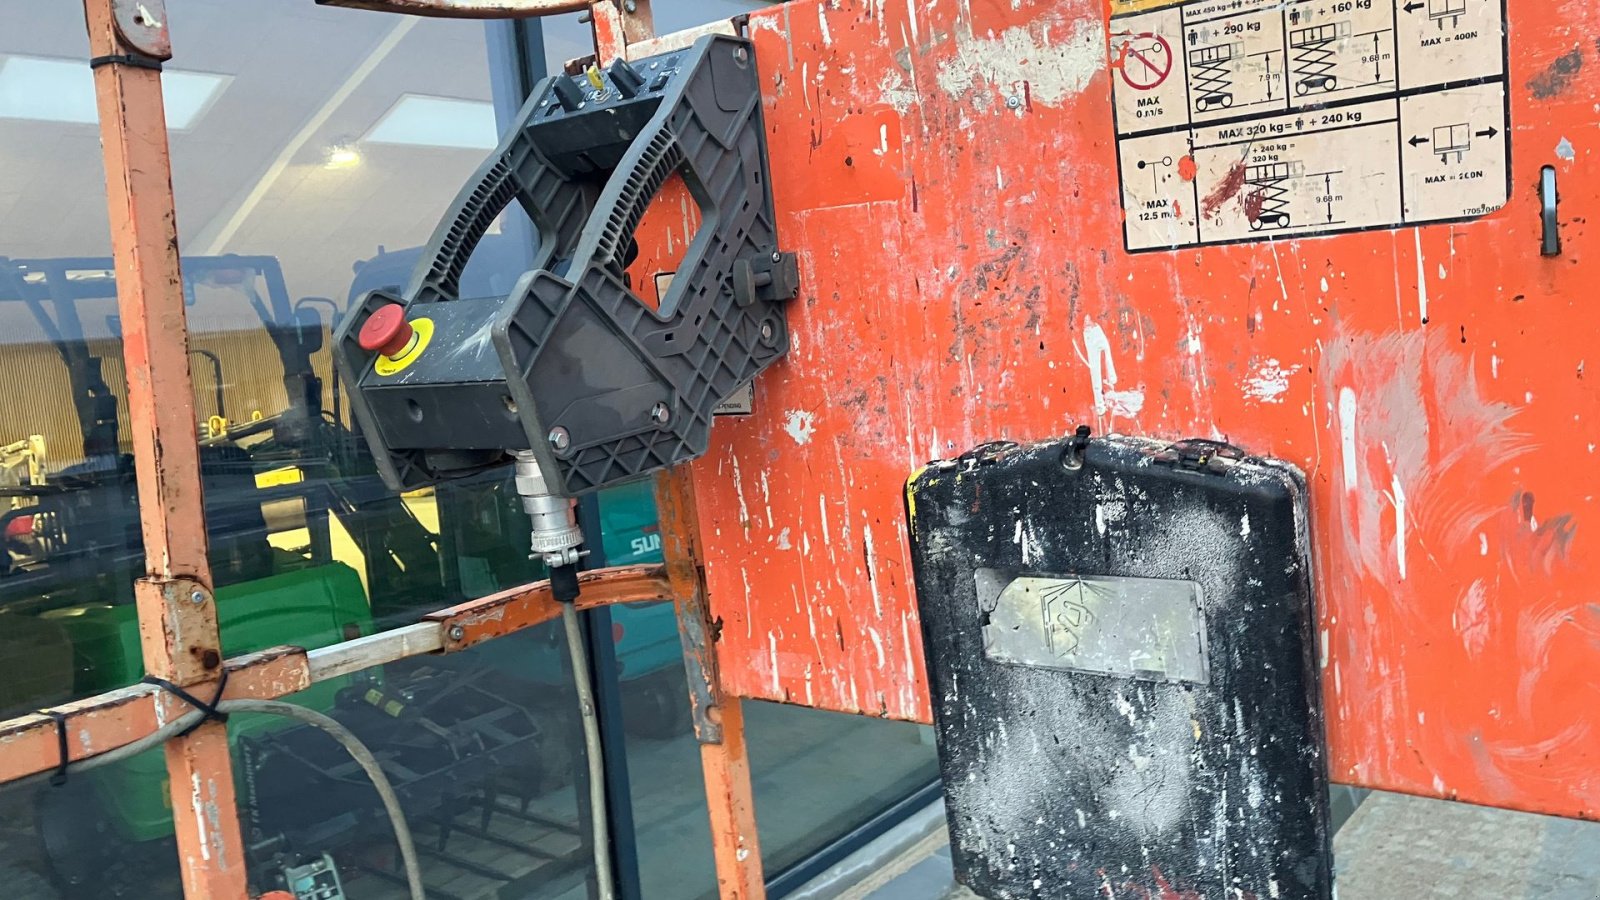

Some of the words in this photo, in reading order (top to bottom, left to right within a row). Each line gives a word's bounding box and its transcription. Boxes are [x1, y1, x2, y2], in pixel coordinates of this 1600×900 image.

[1186, 9, 1201, 17] MAX
[1318, 8, 1326, 16] +
[1331, 2, 1353, 13] 160
[1356, 0, 1372, 9] kg
[1213, 29, 1219, 37] +
[1224, 23, 1243, 35] 290
[1246, 20, 1261, 32] kg
[1421, 37, 1441, 47] MAX
[1454, 31, 1478, 41] 400N
[1361, 52, 1380, 64] 9.68
[1382, 53, 1391, 61] m
[1259, 73, 1271, 82] 7.9
[1137, 96, 1160, 108] MAX
[1219, 127, 1243, 140] MAX
[1246, 124, 1266, 135] 320
[1310, 118, 1317, 126] +
[1322, 112, 1343, 124] 240
[1346, 110, 1362, 122] kg
[1260, 144, 1275, 153] 240
[1276, 143, 1287, 153] kg
[1252, 155, 1267, 163] 320
[1268, 154, 1279, 162] kg
[1425, 175, 1446, 184] MAX
[1146, 199, 1170, 210] MAX
[1315, 194, 1333, 204] 9.68
[1335, 194, 1343, 202] m
[1139, 211, 1158, 222] 12.5
